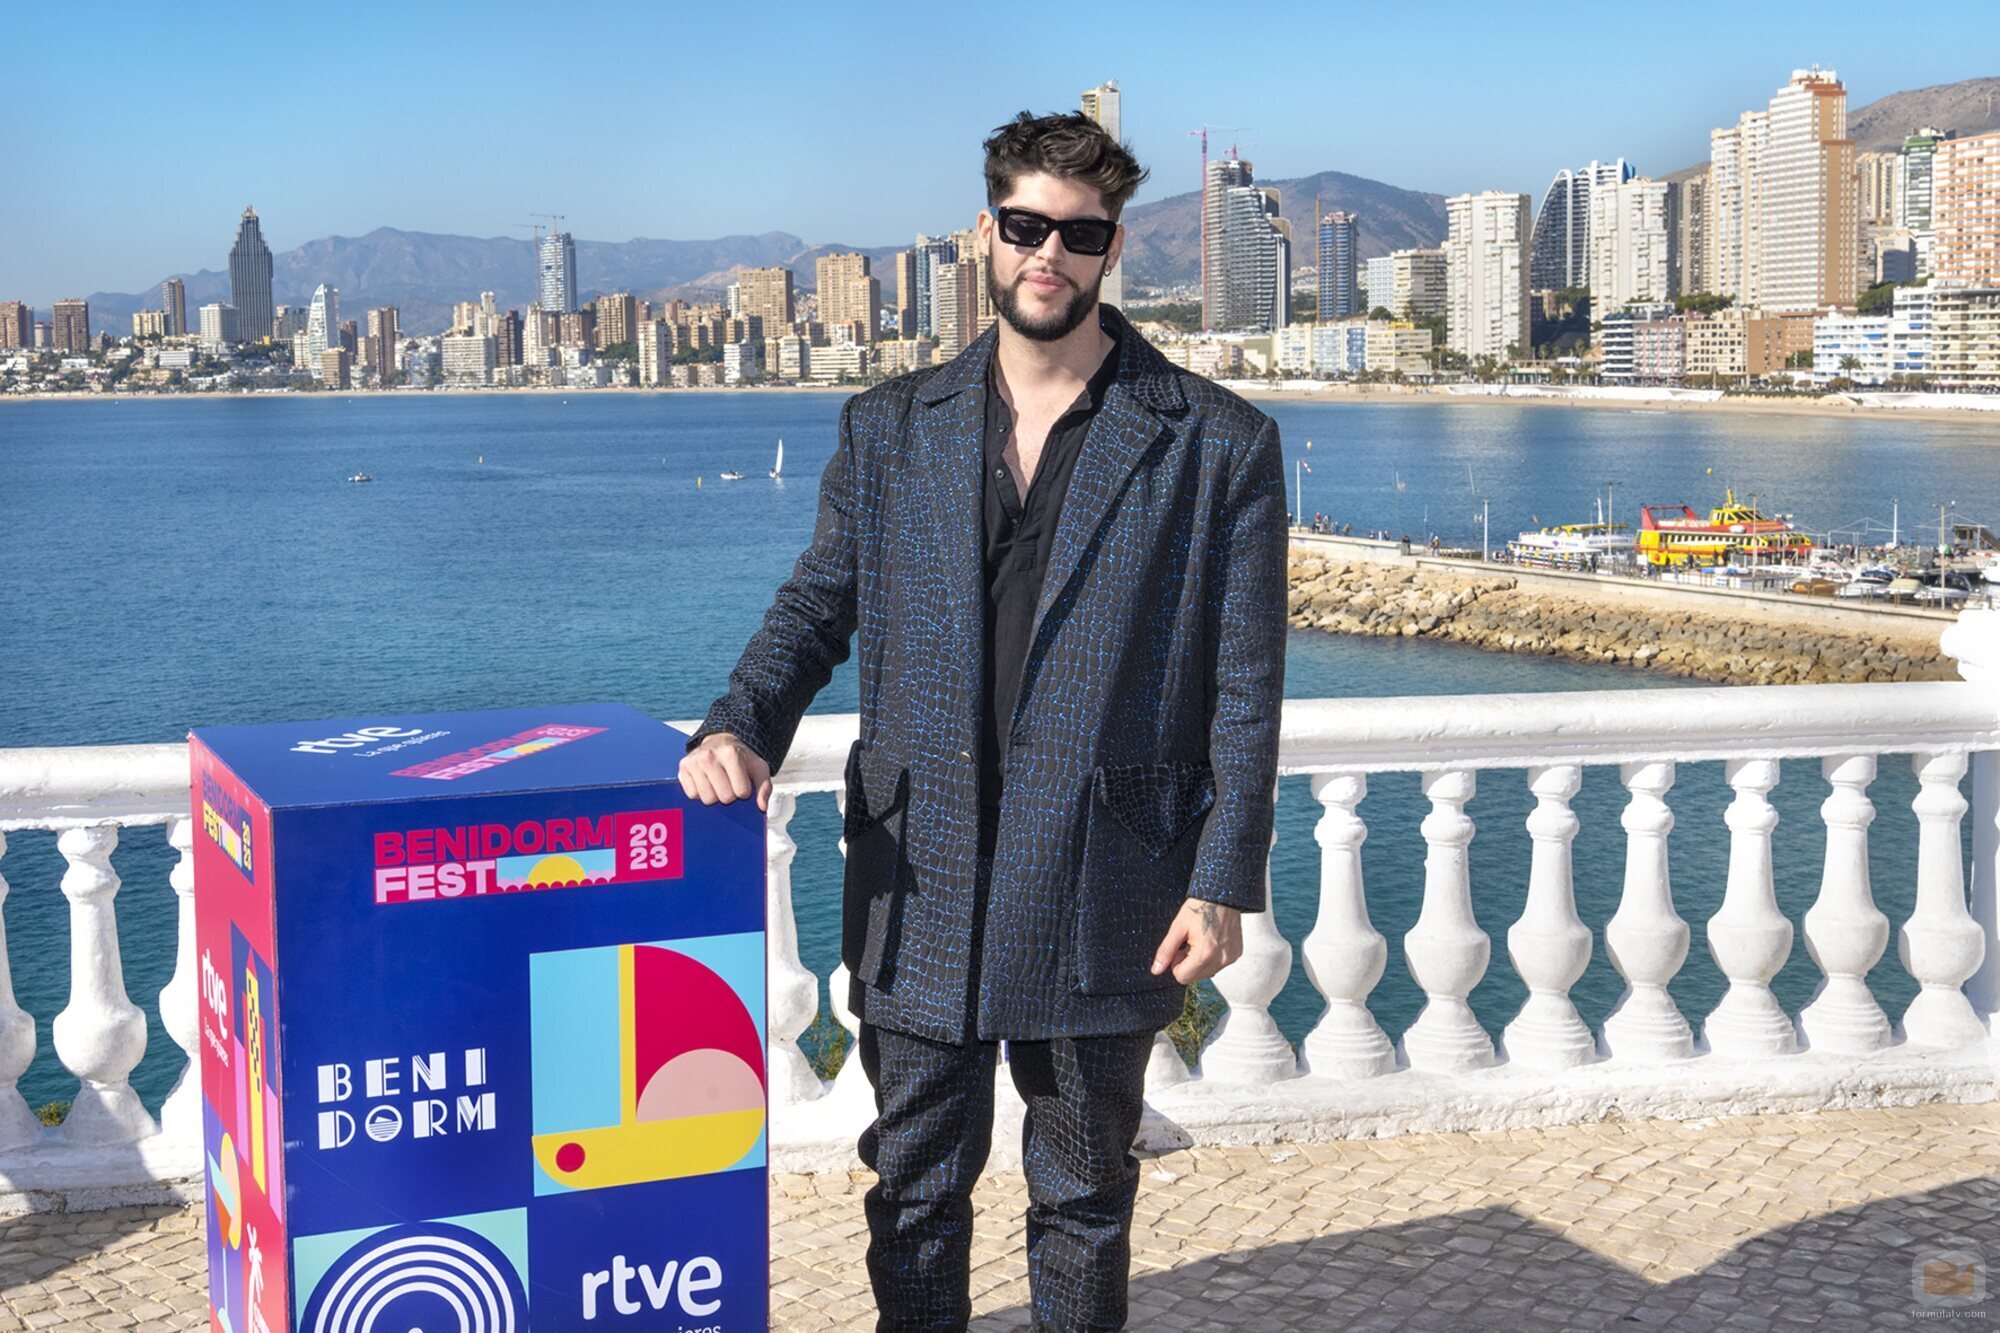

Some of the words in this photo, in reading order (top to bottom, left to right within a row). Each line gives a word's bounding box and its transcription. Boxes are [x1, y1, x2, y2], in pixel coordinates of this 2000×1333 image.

[289, 726, 423, 754] rtve
[420, 755, 508, 780] FEST
[202, 769, 243, 836] BENIDORM
[203, 800, 223, 848] FEST
[374, 815, 614, 866] BENIDORM
[629, 823, 668, 846] 20
[630, 846, 669, 870] 23
[375, 860, 496, 903] FEST
[202, 948, 227, 1040] rtve
[317, 1048, 486, 1103] BENI
[318, 1092, 496, 1150] DORM
[582, 1254, 722, 1320] rtve
